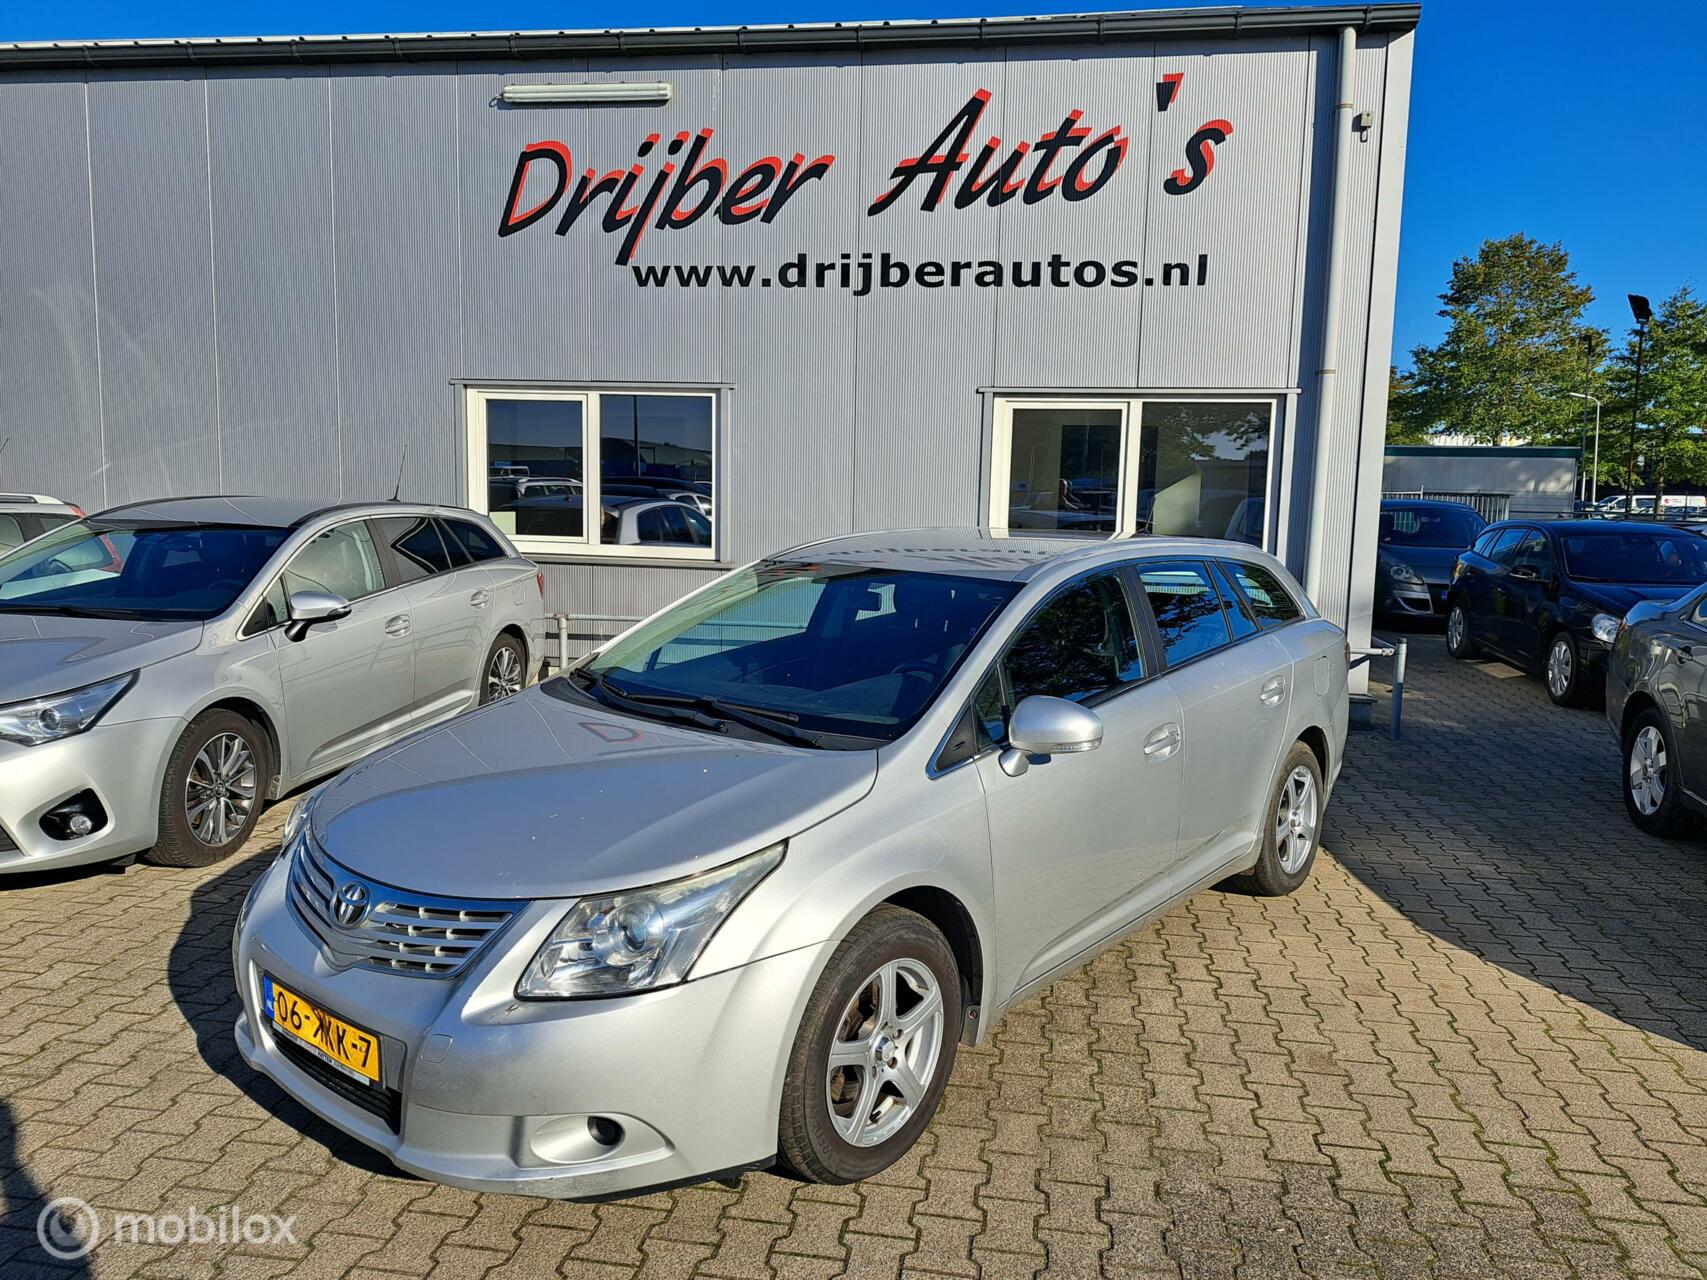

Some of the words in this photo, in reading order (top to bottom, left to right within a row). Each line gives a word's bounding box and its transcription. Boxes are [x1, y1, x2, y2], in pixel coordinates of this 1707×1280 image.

[498, 128, 835, 266] Drijber
[867, 73, 1234, 216] Auto's
[631, 252, 1208, 296] www.drijberautos.nl
